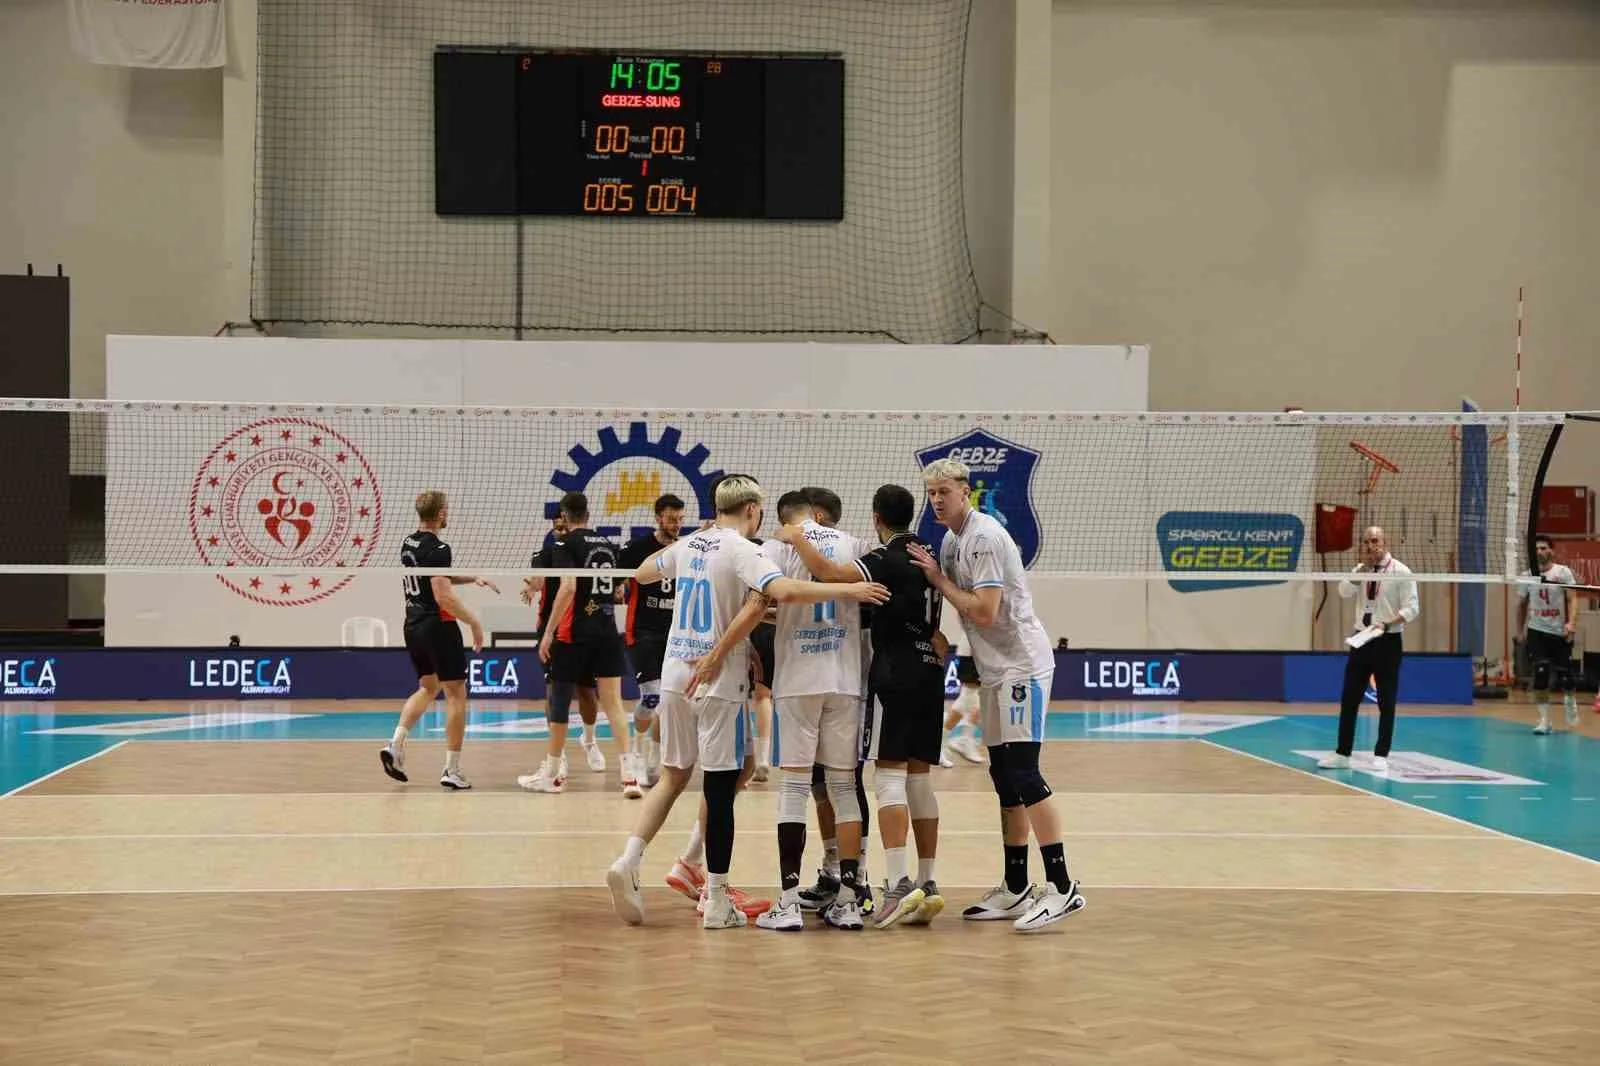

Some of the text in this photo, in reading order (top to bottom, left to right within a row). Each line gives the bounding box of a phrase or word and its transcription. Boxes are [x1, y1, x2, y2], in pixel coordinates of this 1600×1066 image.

[602, 94, 681, 107] GEBZE-SUNG
[595, 125, 629, 152] 00
[651, 126, 685, 153] 00
[584, 184, 633, 211] 005
[646, 185, 697, 212] 004
[948, 447, 1008, 463] GEBZE
[1168, 529, 1240, 541] SPORCU
[1171, 546, 1292, 568] GEBZE
[591, 562, 613, 594] 19
[677, 577, 712, 633] 70
[0, 660, 56, 687] ECA
[190, 659, 290, 686] LEDECA
[465, 660, 518, 686] ECA
[1084, 661, 1179, 688] LEDECA
[1009, 706, 1025, 725] 17
